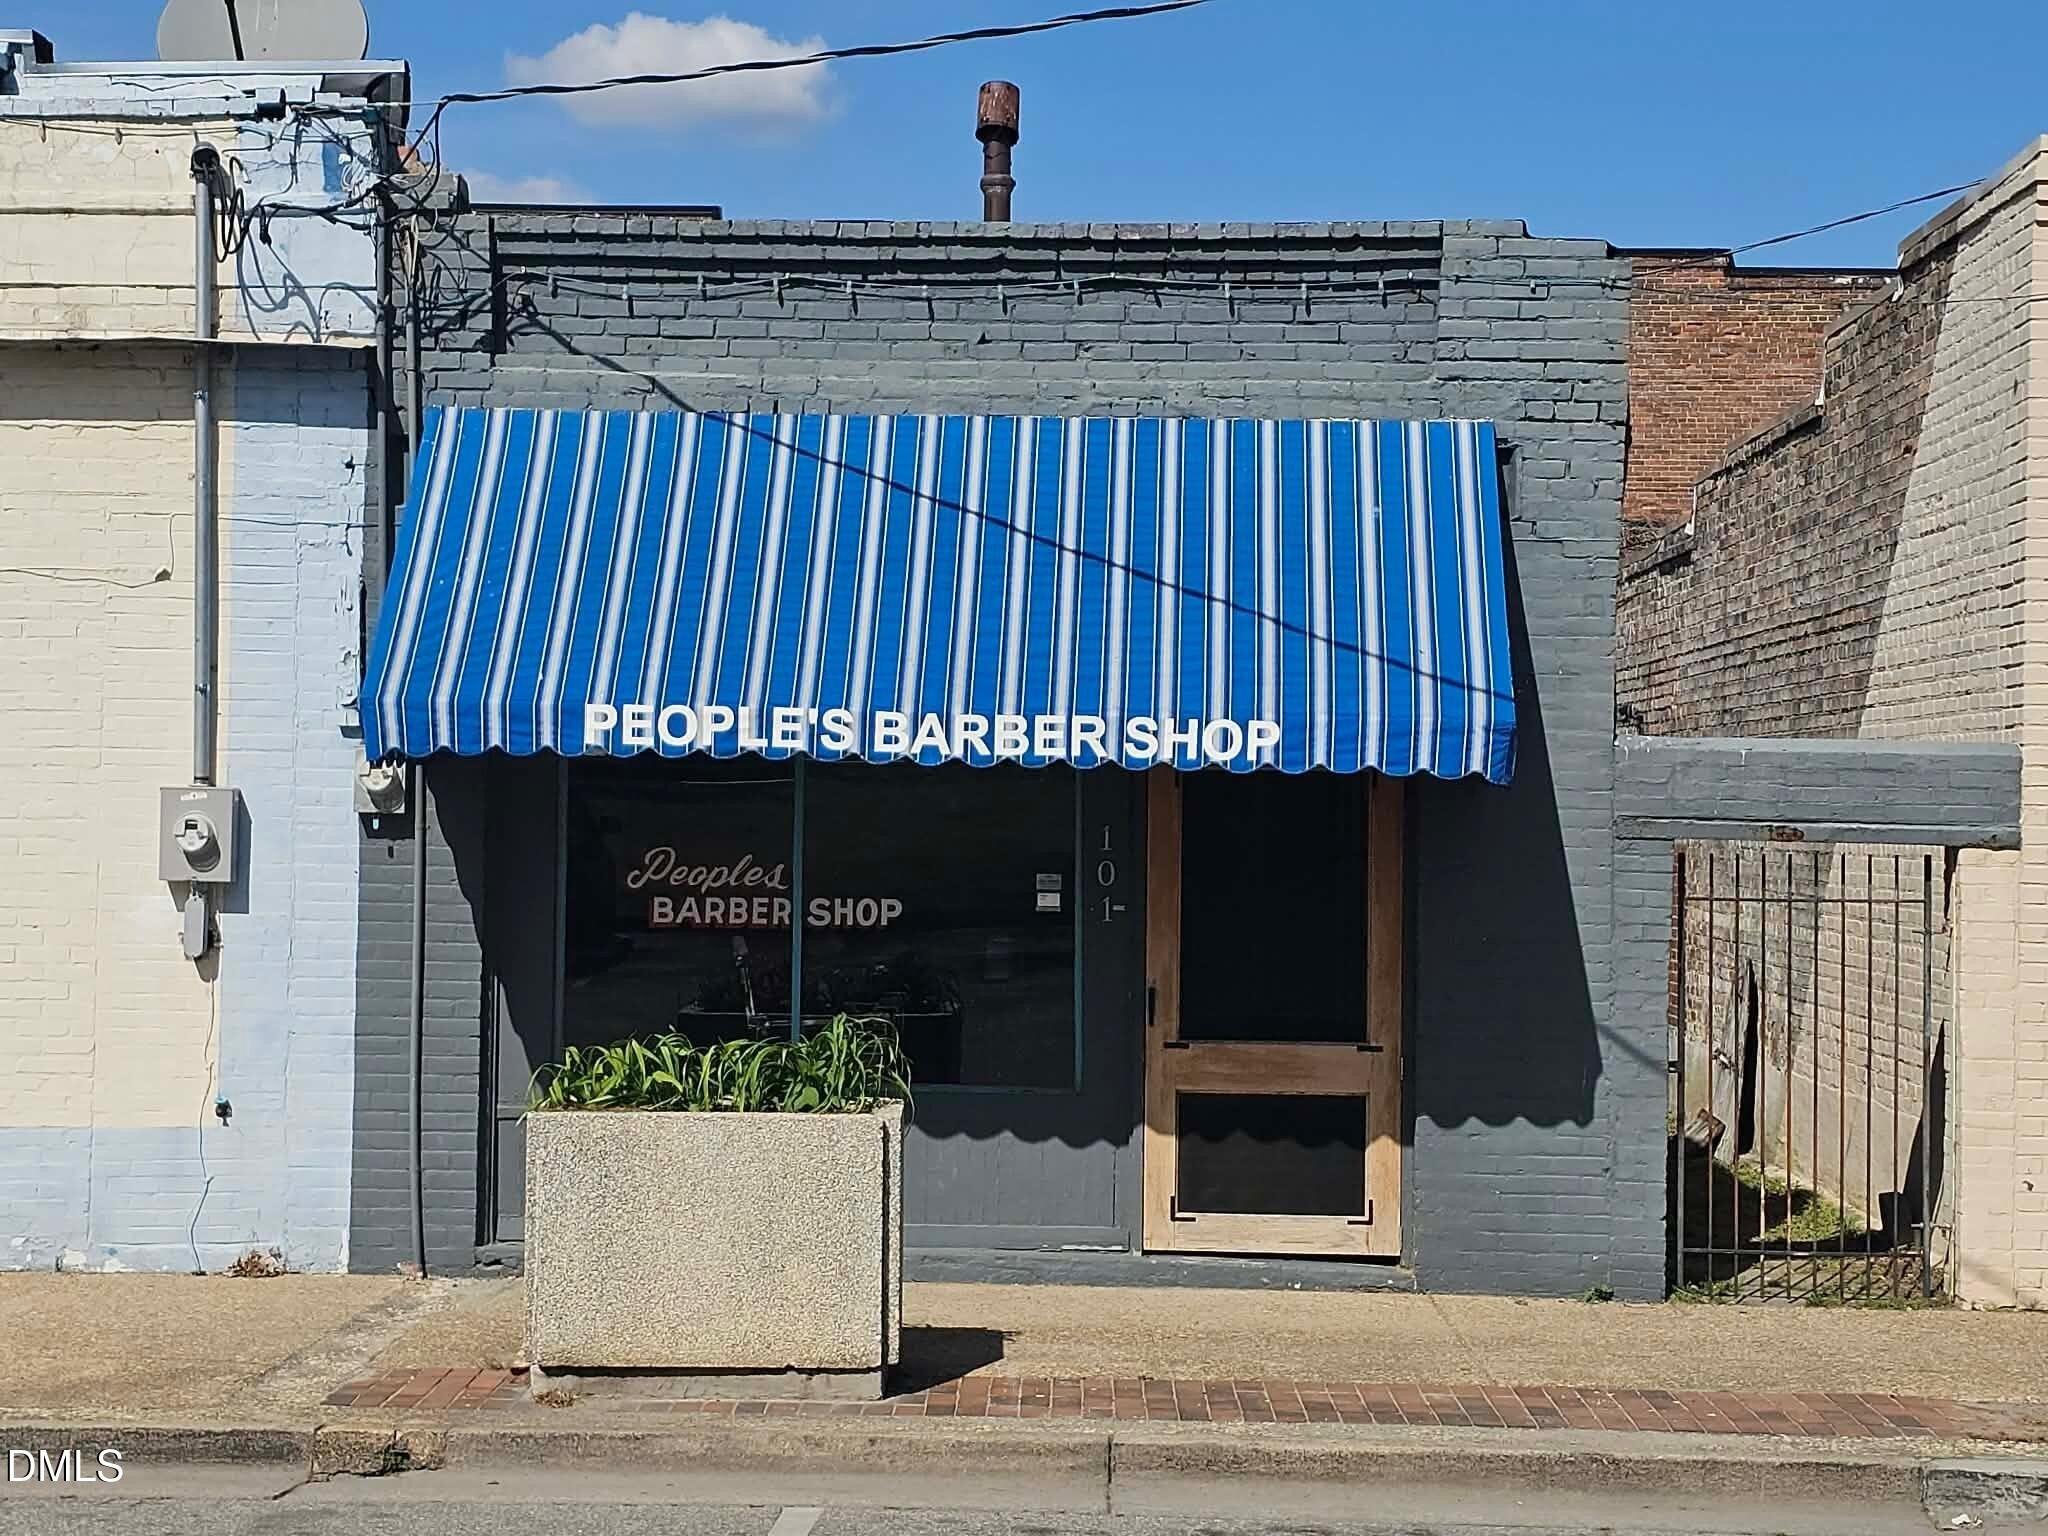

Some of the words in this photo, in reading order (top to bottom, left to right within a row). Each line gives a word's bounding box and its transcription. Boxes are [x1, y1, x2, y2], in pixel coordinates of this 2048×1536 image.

[583, 703, 857, 751] PEOPLE'S
[872, 709, 1108, 759] BARBER
[1124, 716, 1281, 761] SHOP
[626, 846, 790, 894] Peoples
[652, 896, 792, 925] BARBER
[807, 897, 903, 926] SHOP
